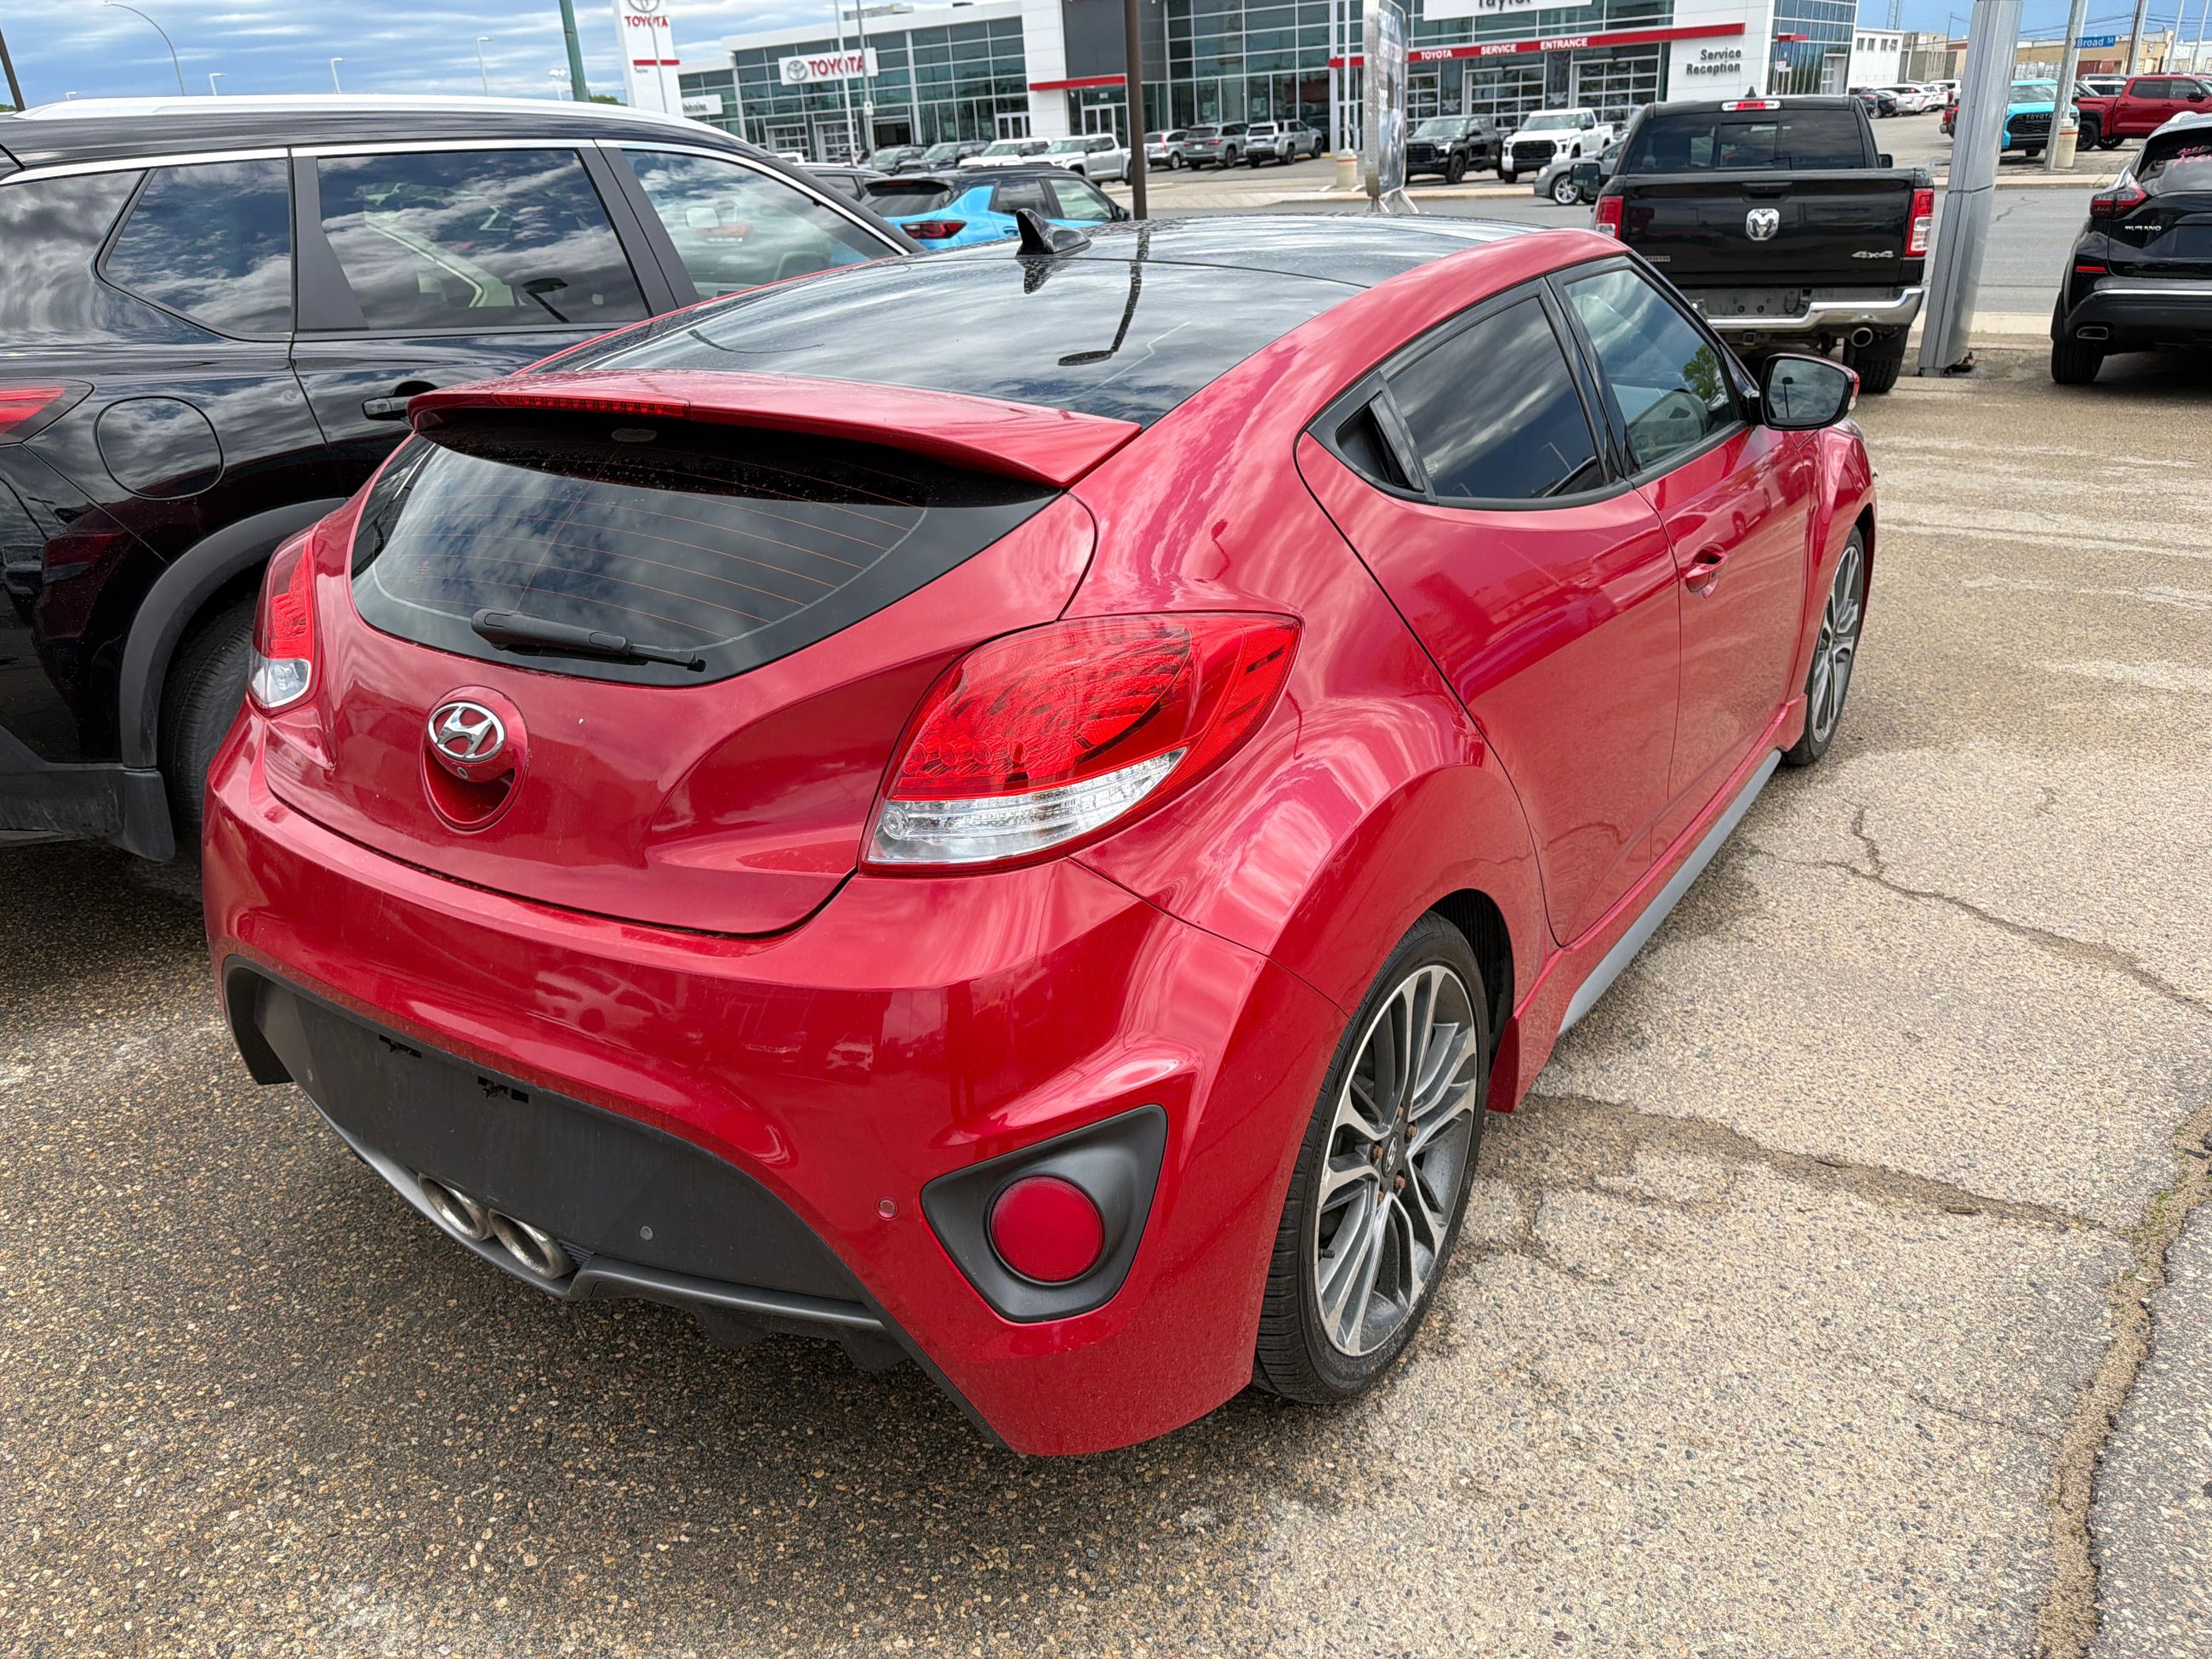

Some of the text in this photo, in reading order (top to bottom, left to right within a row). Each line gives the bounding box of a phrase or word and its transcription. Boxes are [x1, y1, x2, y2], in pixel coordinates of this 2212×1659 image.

[624, 15, 669, 27] TOYOTA
[1420, 37, 1588, 60] TOYOTA SERVICE ENTRANCE
[2077, 37, 2104, 48] Broad
[1700, 47, 1742, 60] Service
[1686, 60, 1741, 76] Reception
